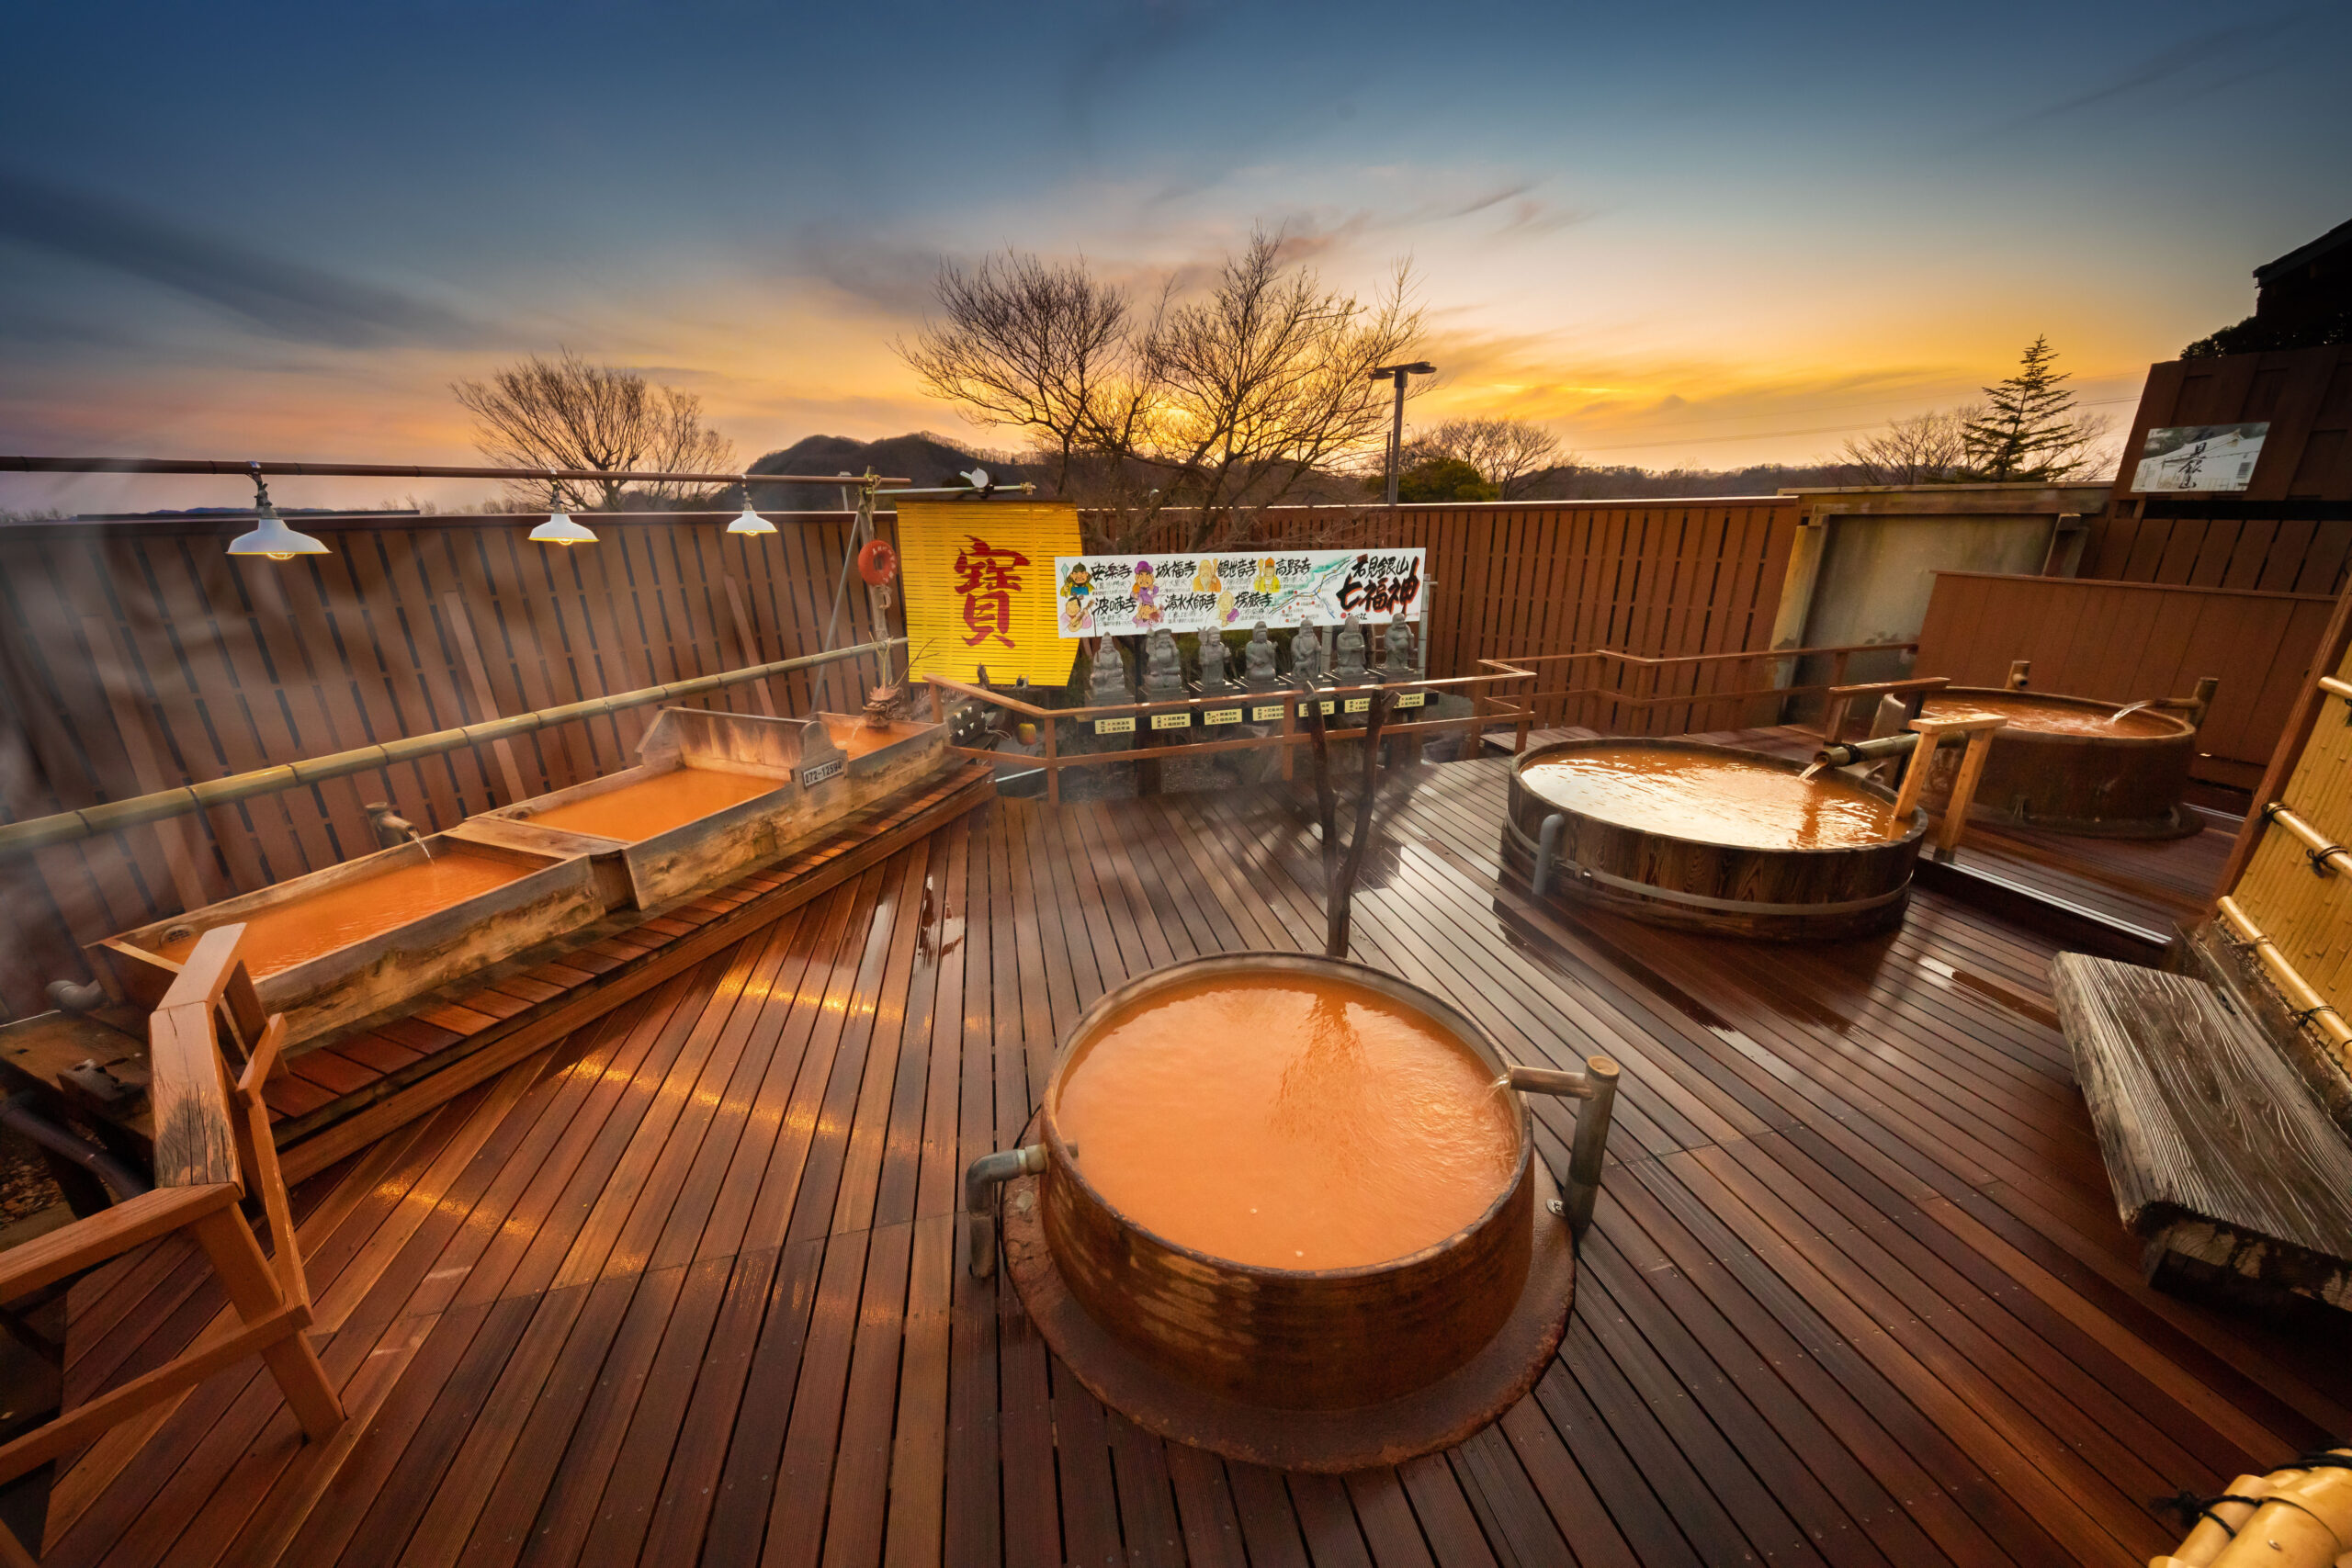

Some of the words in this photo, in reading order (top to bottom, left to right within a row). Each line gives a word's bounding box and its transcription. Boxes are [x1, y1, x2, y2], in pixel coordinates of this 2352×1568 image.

[1091, 563, 1133, 582] 安楽寺
[1156, 560, 1197, 580] 城福寺
[1217, 558, 1258, 578] 観世音寺
[1275, 557, 1312, 576] 高野寺
[1351, 556, 1409, 579] 石見銀山
[955, 535, 1031, 649] 寶
[1336, 556, 1420, 616] 七福神
[1164, 592, 1218, 612] 清水大師寺
